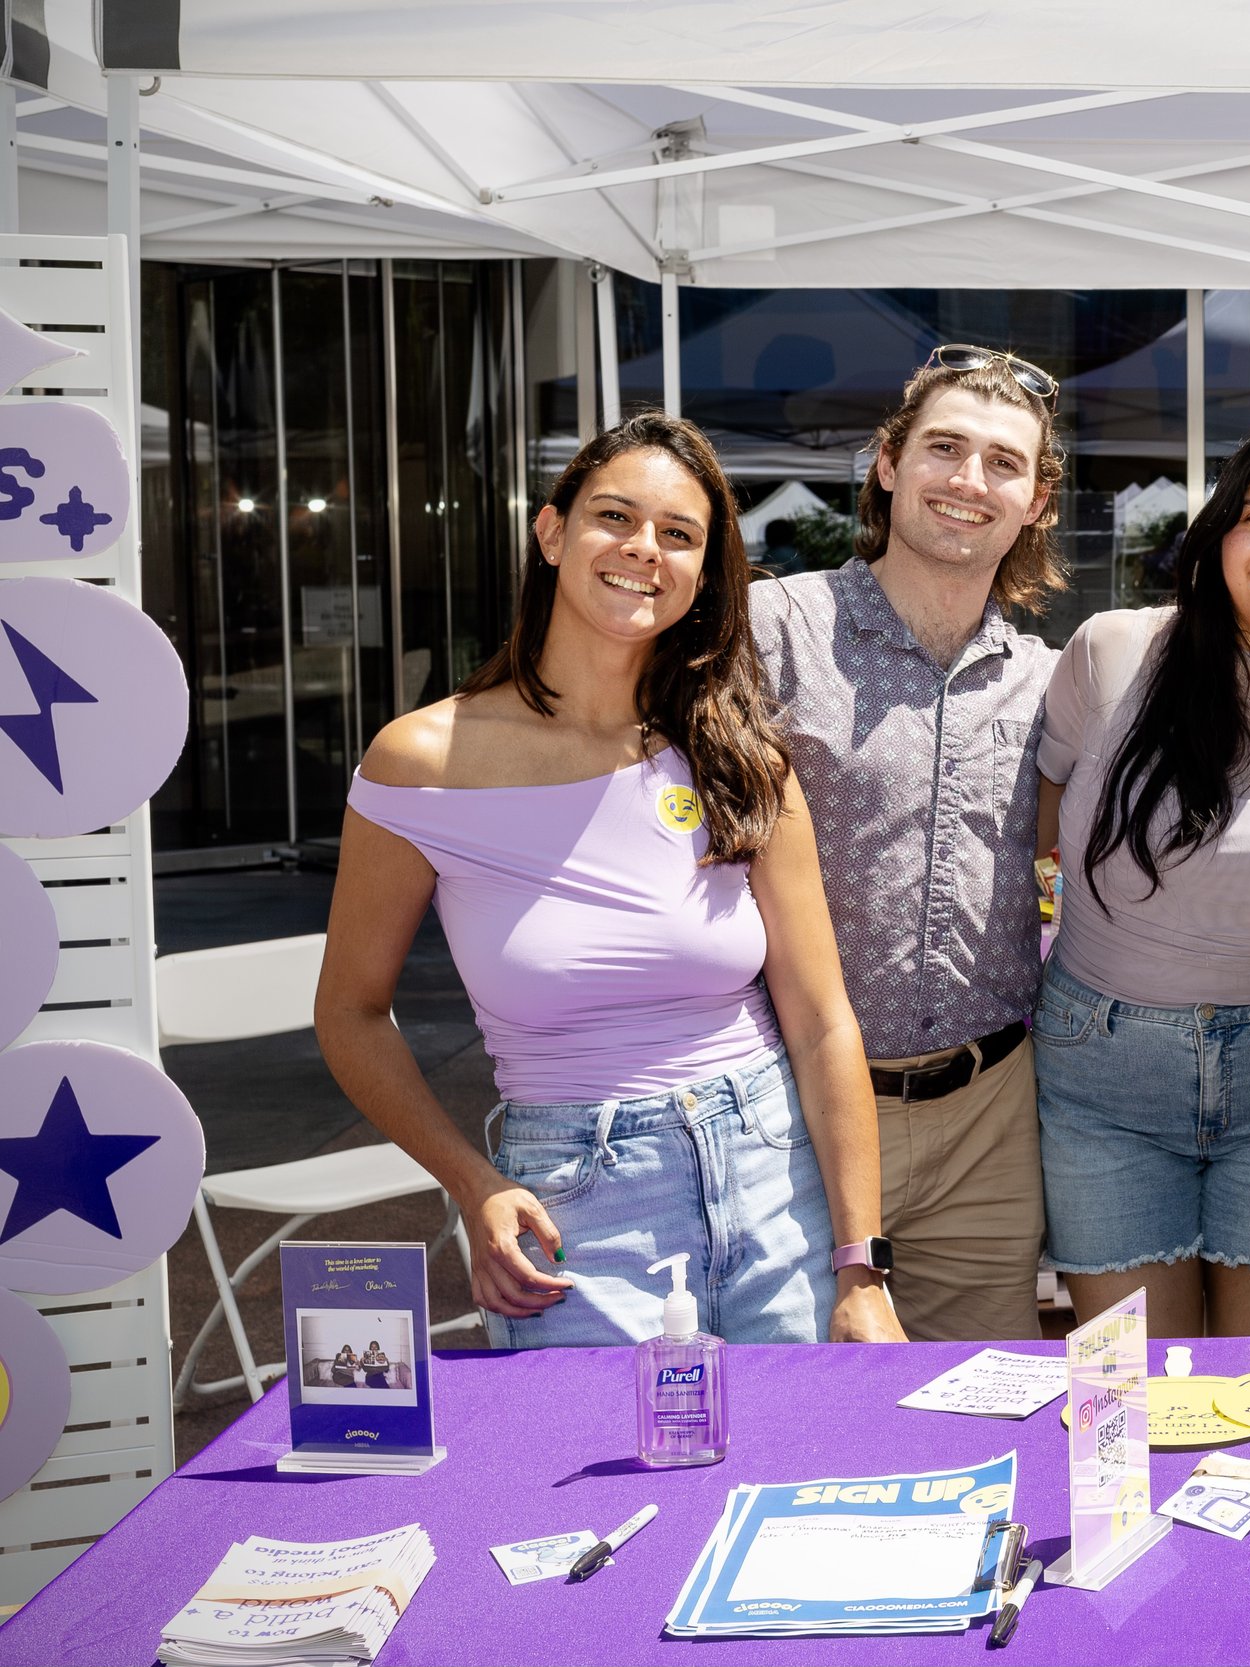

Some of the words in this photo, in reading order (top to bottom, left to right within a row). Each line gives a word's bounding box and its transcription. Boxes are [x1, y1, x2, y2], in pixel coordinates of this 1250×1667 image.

[1123, 1307, 1137, 1334] US
[988, 1354, 1037, 1364] media
[1102, 1352, 1117, 1377] ON
[662, 1368, 700, 1382] Purell
[993, 1370, 1042, 1380] belong
[960, 1385, 1028, 1396] world
[1093, 1373, 1139, 1416] Instagram
[960, 1394, 1027, 1404] build
[345, 1428, 379, 1440] ciaooo!
[791, 1482, 901, 1506] SIGN
[911, 1475, 976, 1504] UP
[329, 1530, 408, 1557] ciaooo!
[254, 1545, 325, 1558] media
[348, 1558, 383, 1572] can
[244, 1568, 266, 1576] to
[272, 1567, 341, 1579] belong
[238, 1595, 333, 1611] world
[733, 1602, 803, 1614] ciaooo!
[843, 1600, 968, 1612] CIAOOOMEDIA.COM
[214, 1609, 235, 1620] a
[242, 1606, 335, 1627] build
[228, 1629, 250, 1637] to
[254, 1627, 300, 1638] how
